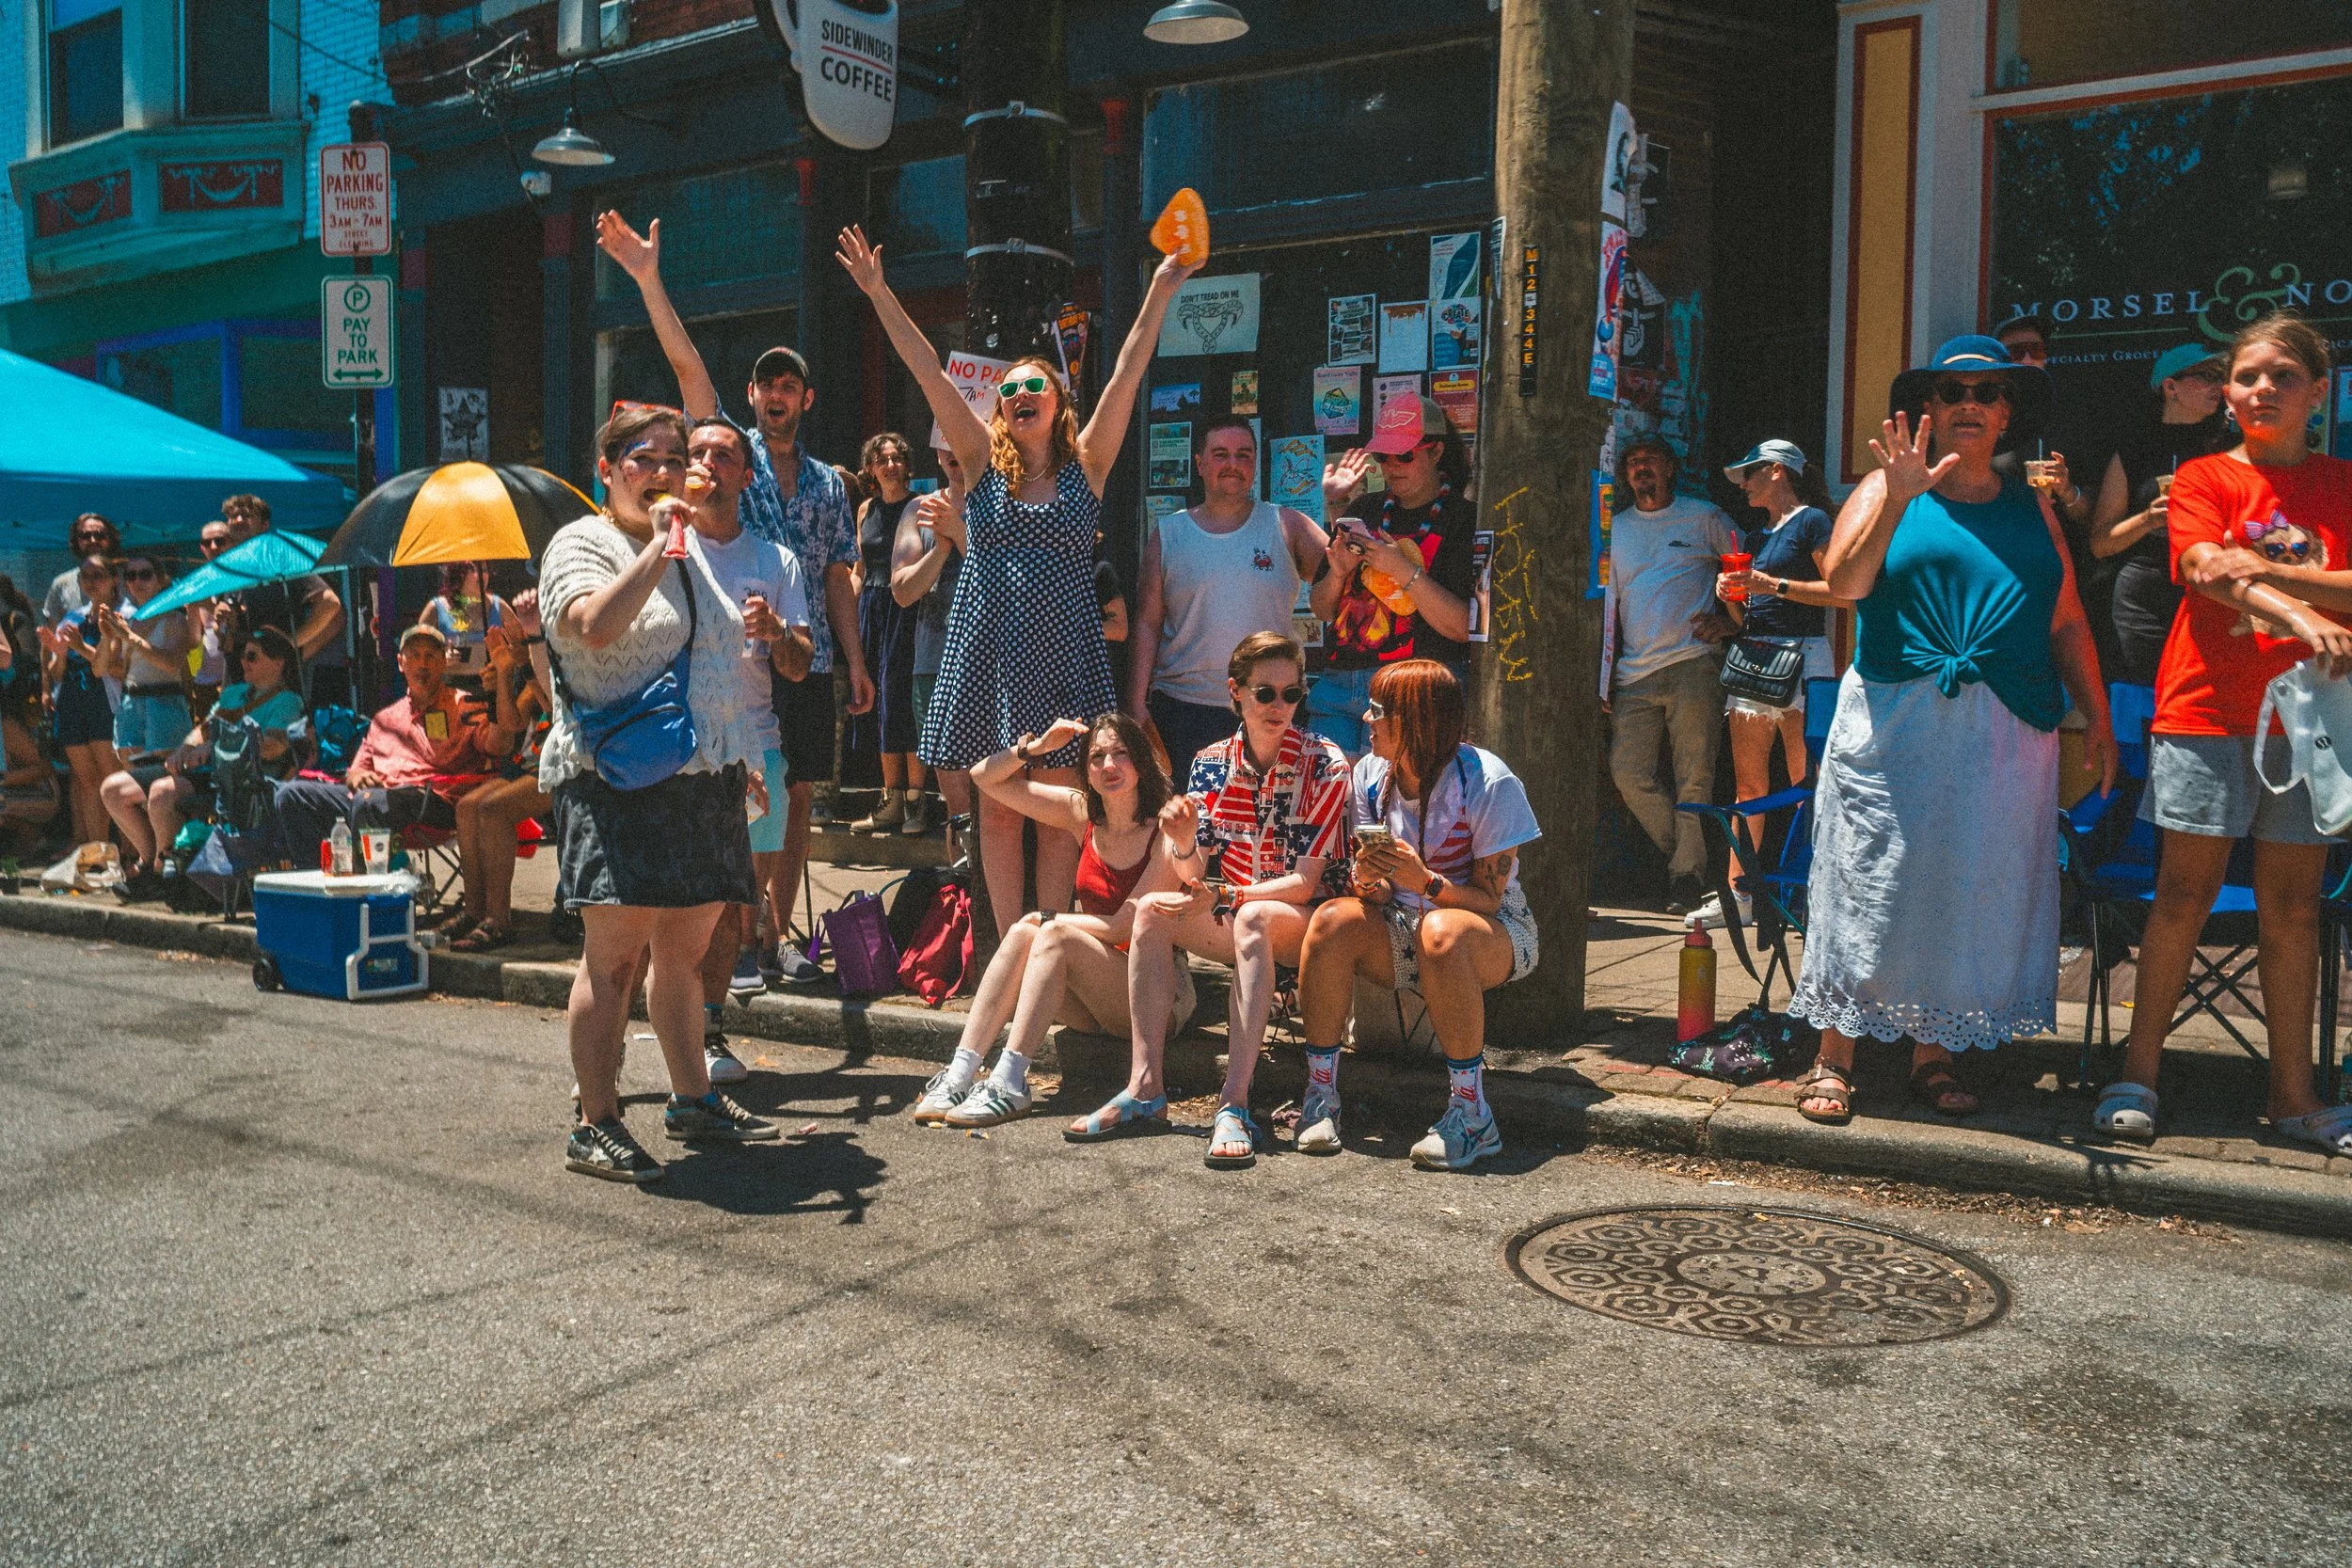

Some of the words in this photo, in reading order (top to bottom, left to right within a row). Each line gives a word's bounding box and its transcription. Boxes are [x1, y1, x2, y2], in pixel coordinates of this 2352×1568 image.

[821, 19, 893, 65] SIDEWINDER
[820, 56, 892, 103] COFFEE
[342, 151, 366, 171] NO
[326, 173, 383, 194] PARKING
[335, 196, 377, 211] THURS.
[329, 214, 352, 228] 3AM
[362, 213, 382, 228] 7AM
[1181, 293, 1200, 303] DON'T
[1200, 292, 1219, 300] TREAD
[1220, 291, 1230, 299] ON
[1231, 290, 1240, 298] ME
[2010, 290, 2210, 322] MORSEL
[2286, 279, 2352, 307] NO
[343, 318, 371, 332] PAY
[349, 334, 367, 348] TO
[338, 349, 378, 365] PARK
[2043, 352, 2106, 366] PECIALTY
[2112, 349, 2161, 362] GROCE
[949, 359, 976, 379] NO
